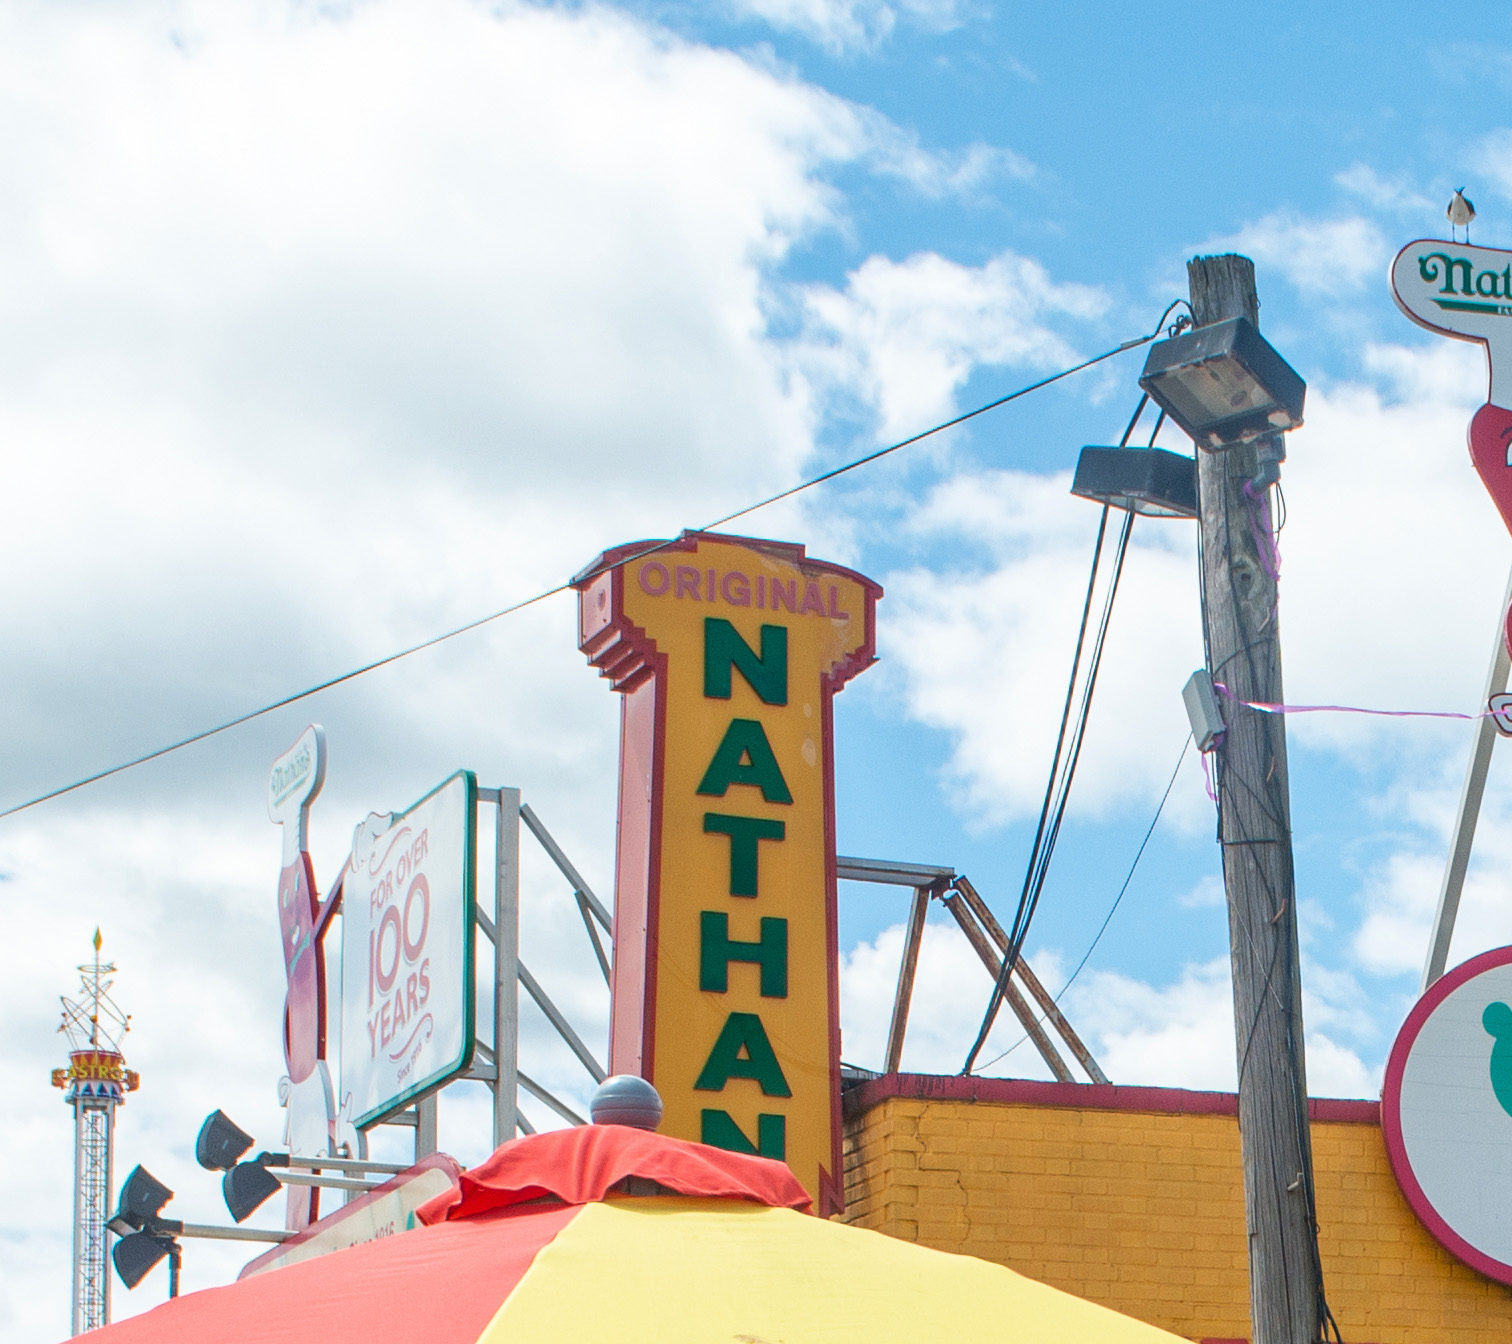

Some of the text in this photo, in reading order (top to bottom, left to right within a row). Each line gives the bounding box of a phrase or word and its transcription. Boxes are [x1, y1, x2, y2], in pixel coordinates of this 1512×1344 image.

[637, 561, 849, 620] ORIGINAL
[370, 828, 428, 916] FOR OVER
[367, 958, 431, 1060] YEARS
